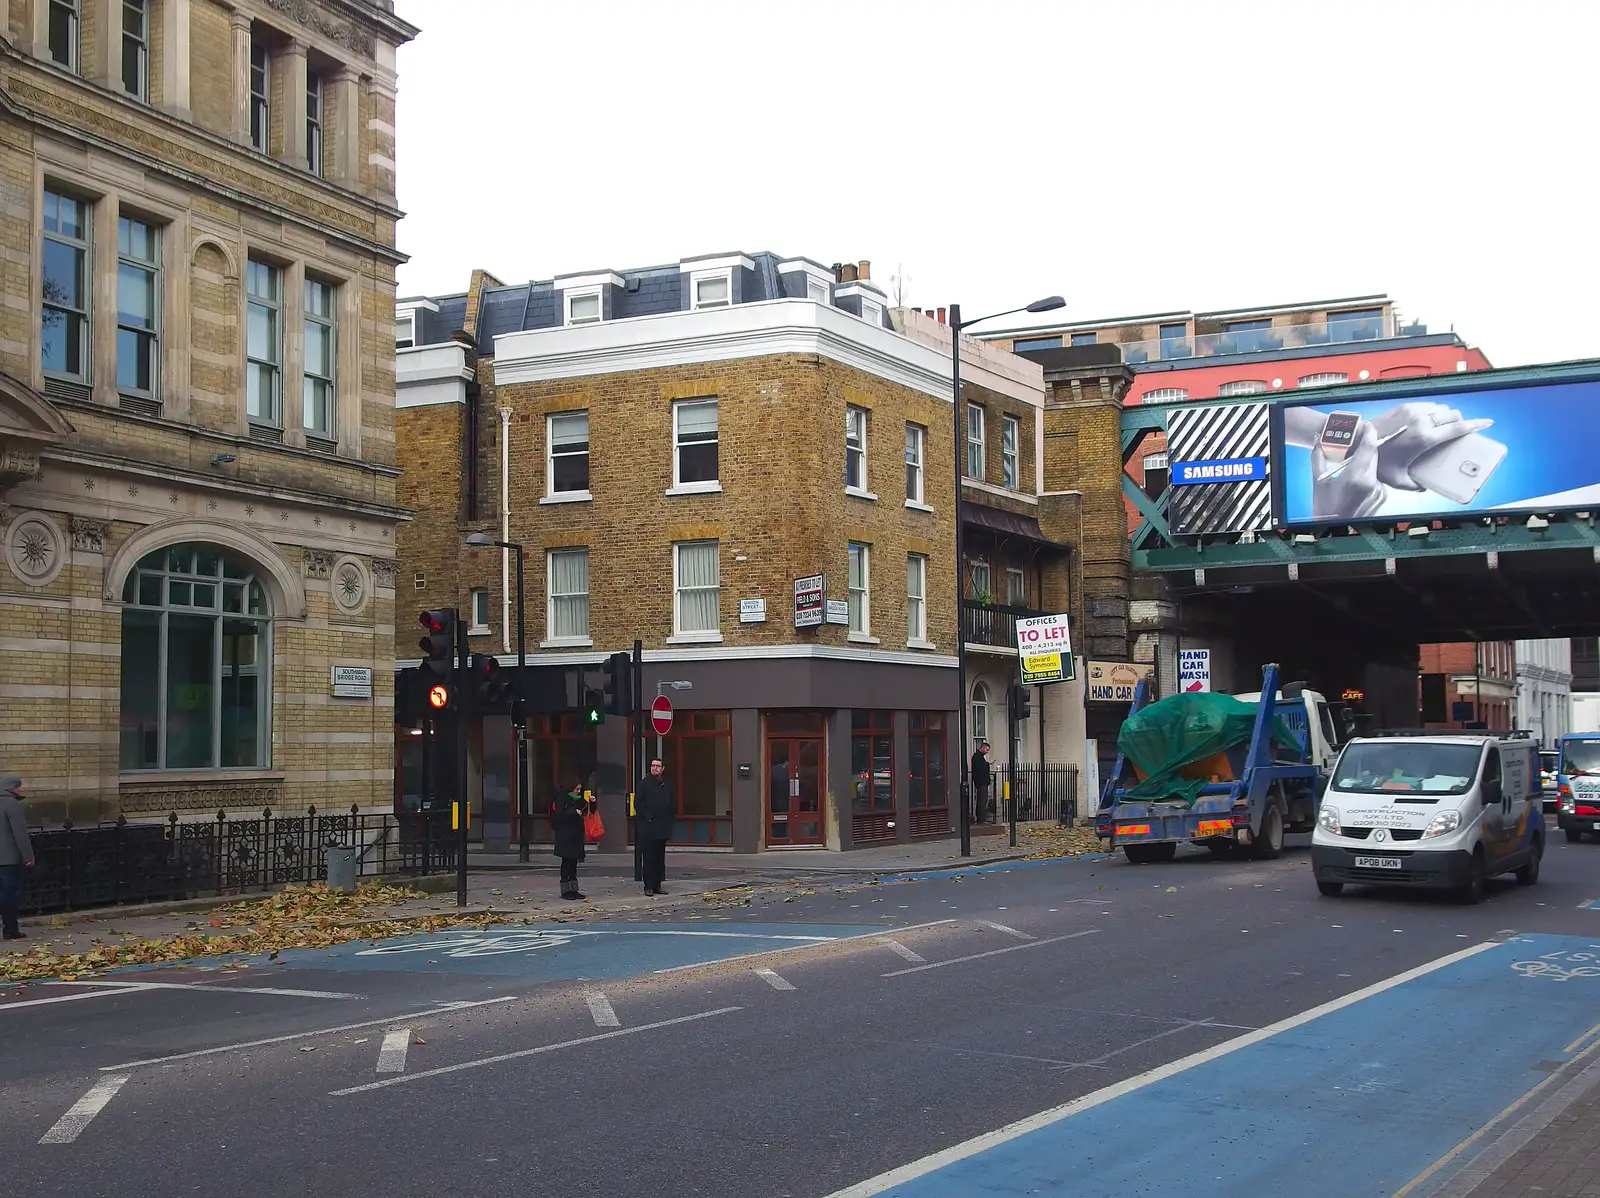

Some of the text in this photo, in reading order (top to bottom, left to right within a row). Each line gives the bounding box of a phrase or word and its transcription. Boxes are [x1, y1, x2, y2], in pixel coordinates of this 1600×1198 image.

[1183, 462, 1253, 479] SAMSUNG
[809, 593, 820, 602] SONS
[1026, 616, 1057, 626] OFFICES
[1019, 626, 1066, 642] TO LET
[1180, 651, 1208, 660] HAND
[1029, 662, 1056, 670] Symmons
[1182, 661, 1204, 670] CAR
[1180, 671, 1208, 680] WASH
[1092, 686, 1132, 699] HAND CAR
[1359, 858, 1398, 868] AP08 UKN
